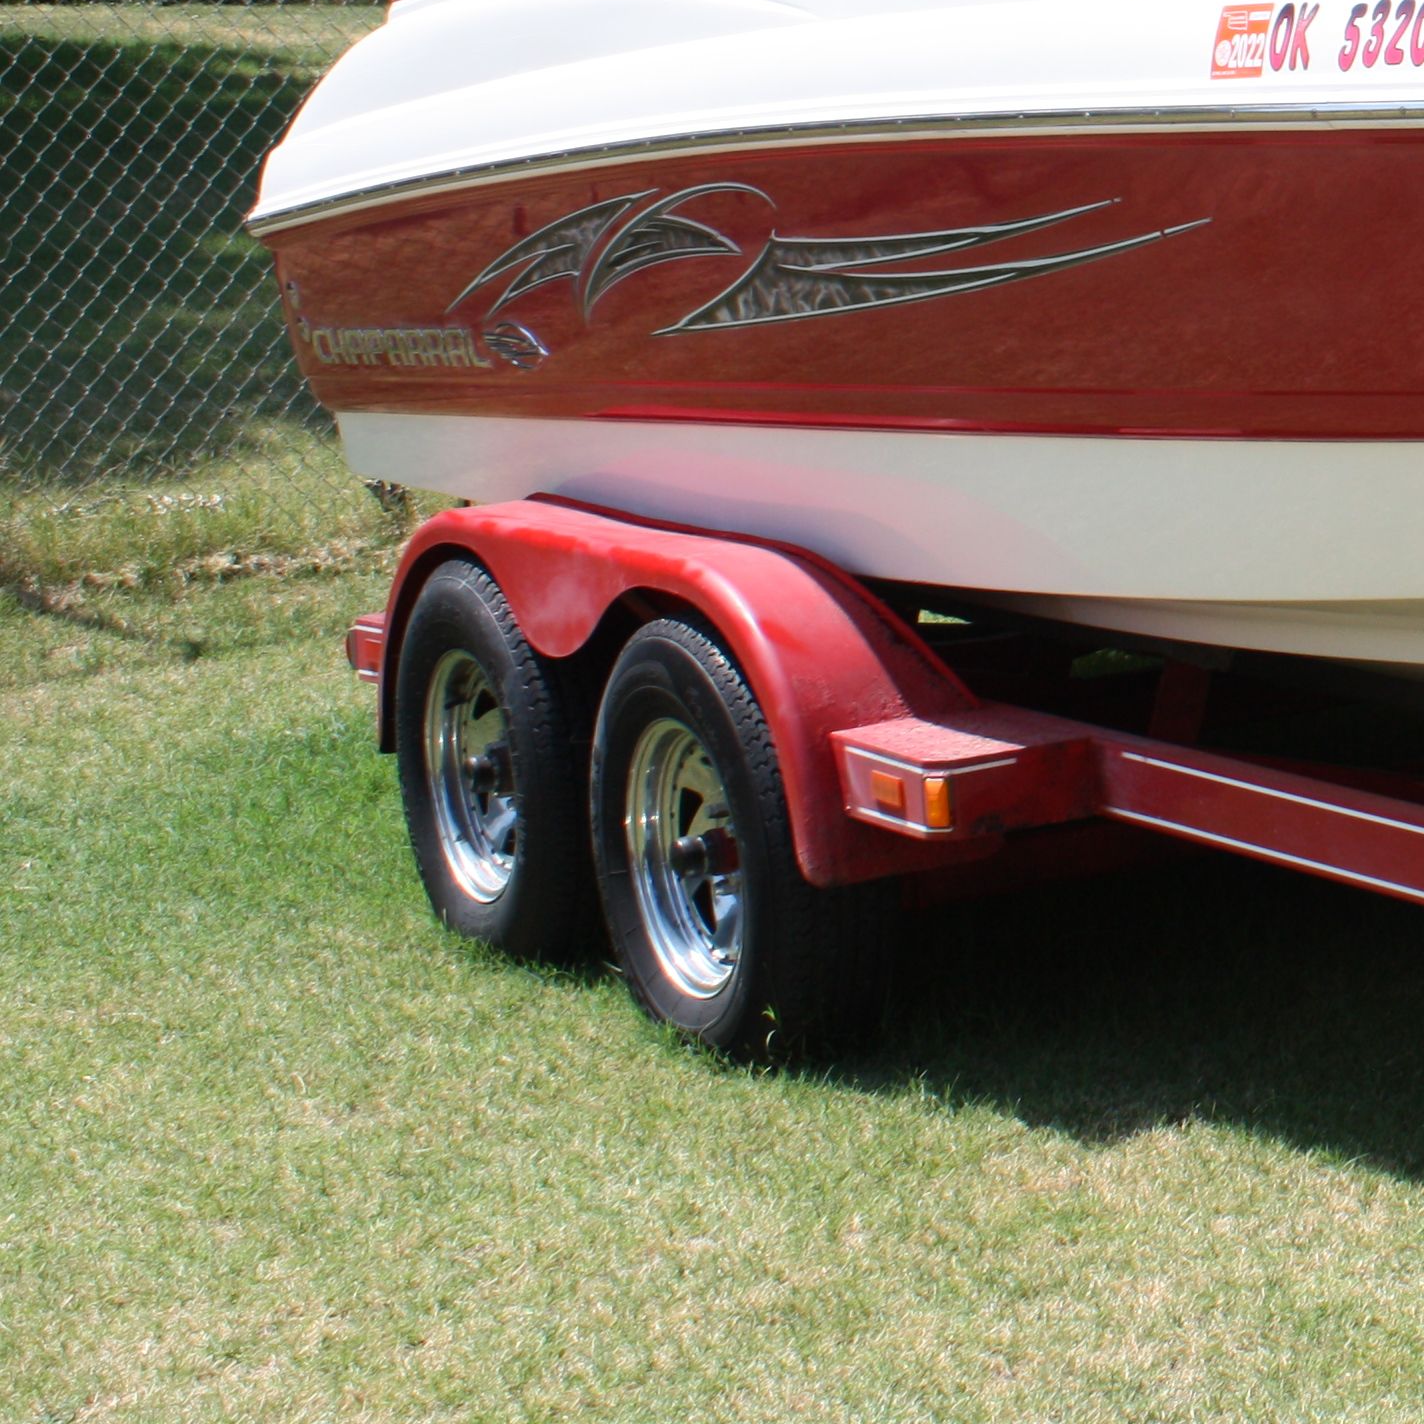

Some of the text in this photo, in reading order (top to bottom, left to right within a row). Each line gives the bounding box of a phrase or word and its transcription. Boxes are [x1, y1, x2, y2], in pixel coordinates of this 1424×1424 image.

[1227, 33, 1266, 68] 2022
[1269, 2, 1320, 71] OK
[312, 328, 492, 367] CHAPARRAL
